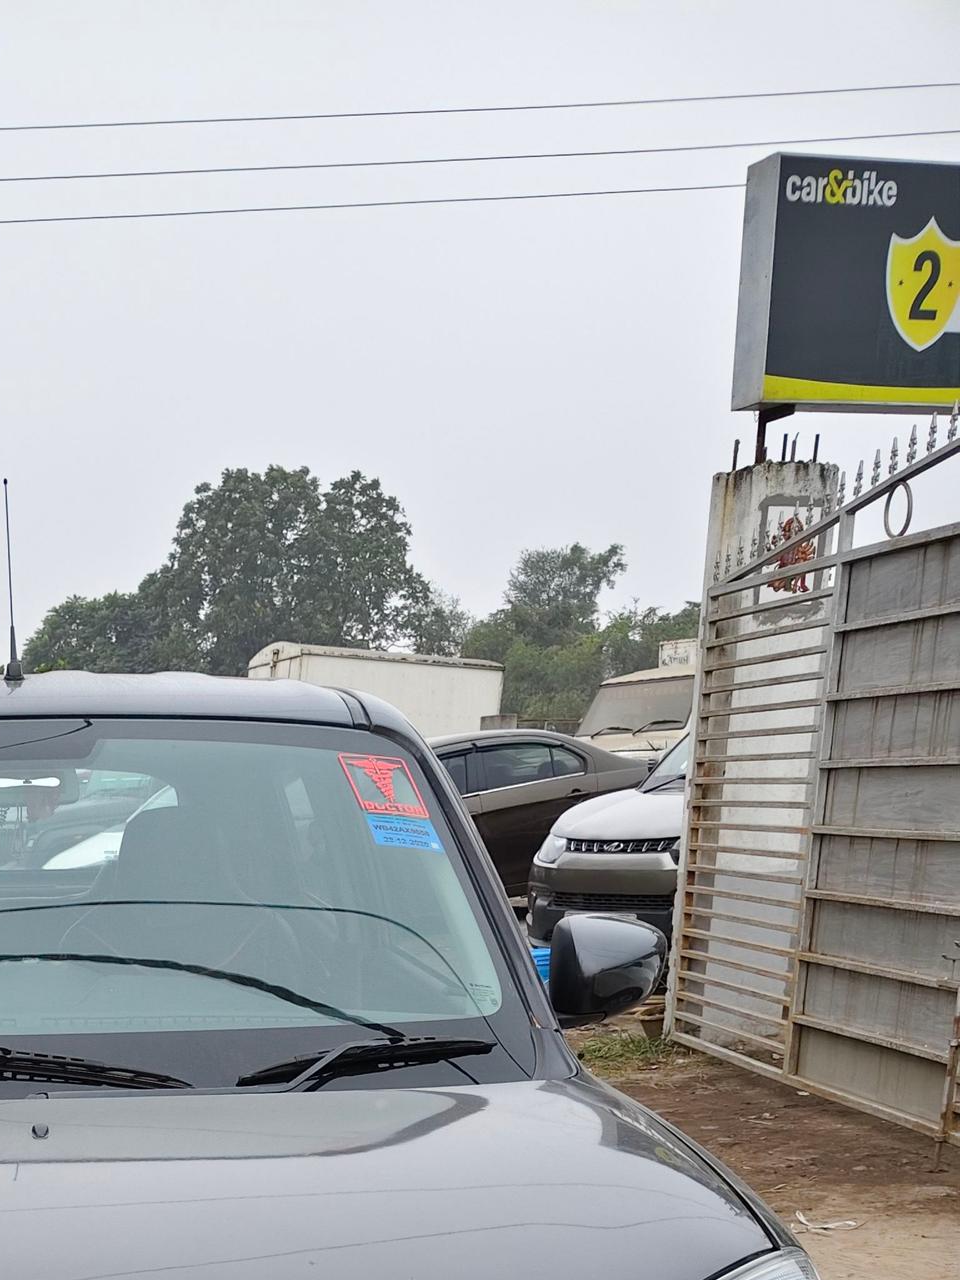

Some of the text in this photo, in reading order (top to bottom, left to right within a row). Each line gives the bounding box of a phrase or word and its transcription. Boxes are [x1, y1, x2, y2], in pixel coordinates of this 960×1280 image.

[786, 169, 898, 206] car&bike
[908, 249, 941, 321] 2
[364, 801, 425, 815] DOCTOR
